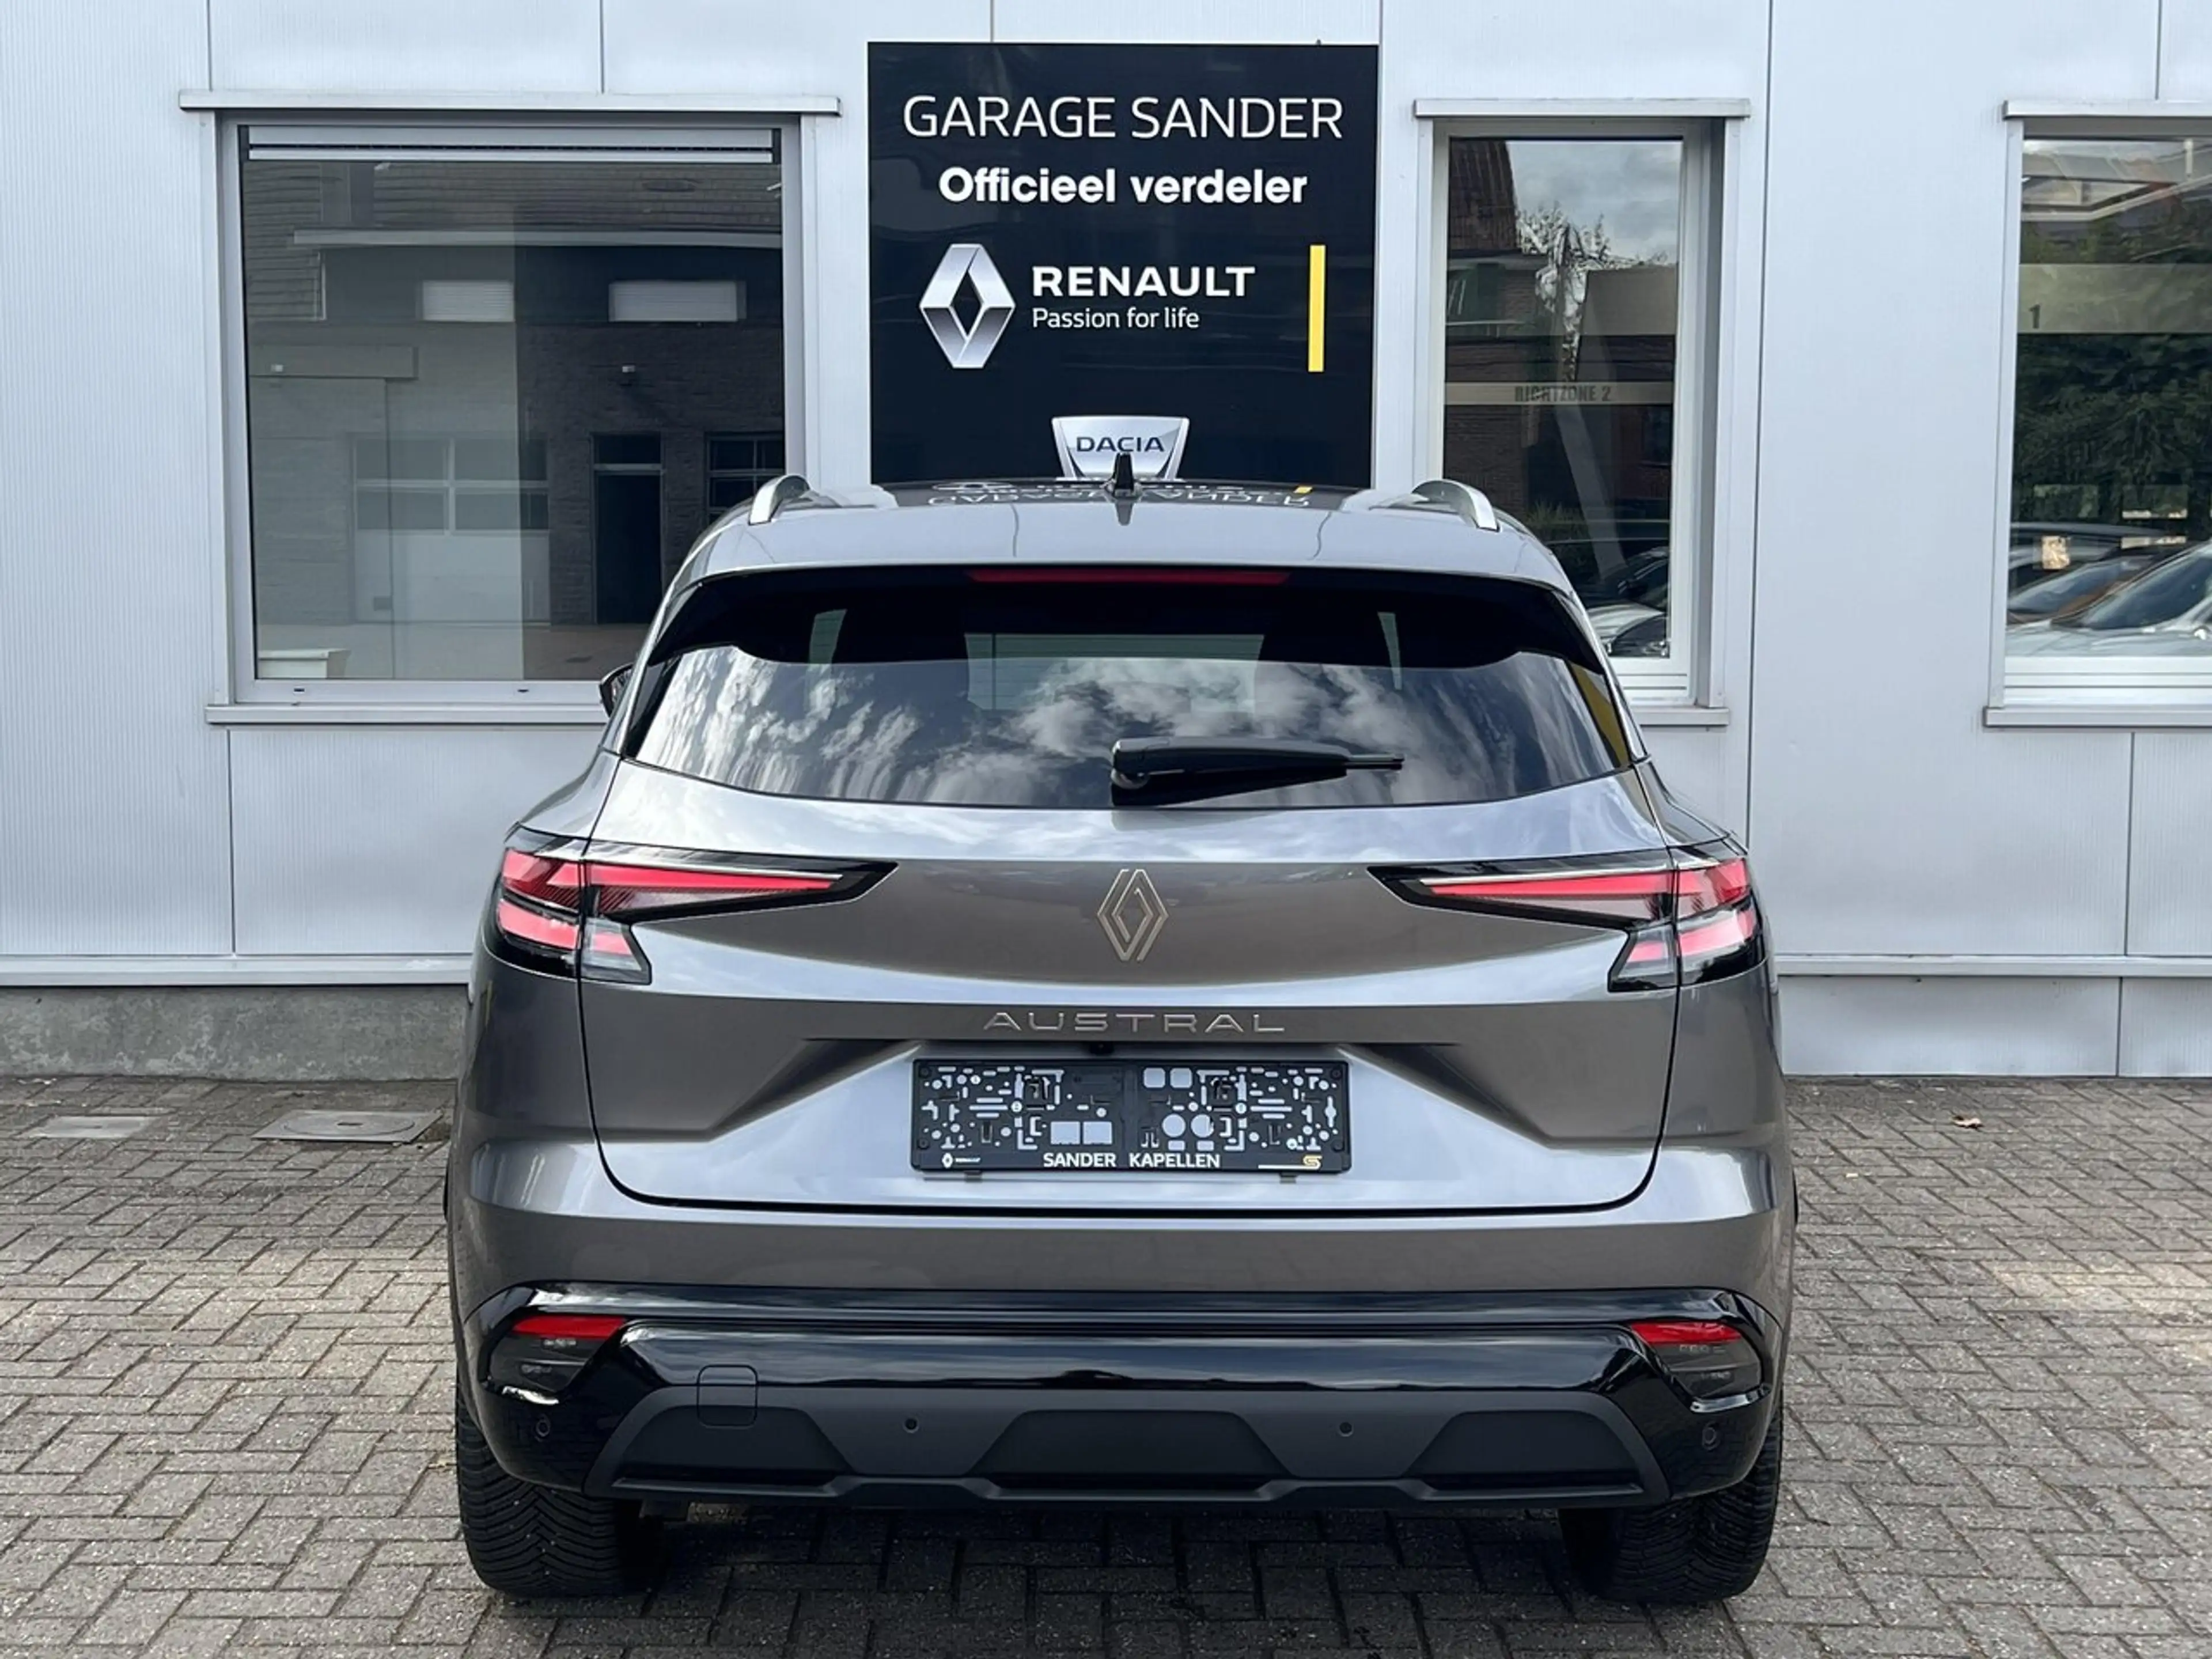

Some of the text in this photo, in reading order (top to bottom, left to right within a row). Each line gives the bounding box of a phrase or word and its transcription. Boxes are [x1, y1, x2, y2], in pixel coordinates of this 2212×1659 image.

[904, 95, 1343, 138] GARAGE SANDER
[939, 166, 1308, 203] Officieel verdeler
[1032, 266, 1255, 297] RENAULT
[1032, 306, 1200, 328] Passion for life
[1601, 385, 1612, 402] 2
[1076, 436, 1164, 453] DACIA
[983, 1012, 1285, 1033] AUSTRAL
[1043, 1152, 1221, 1169] SANDER KAPELLEN
